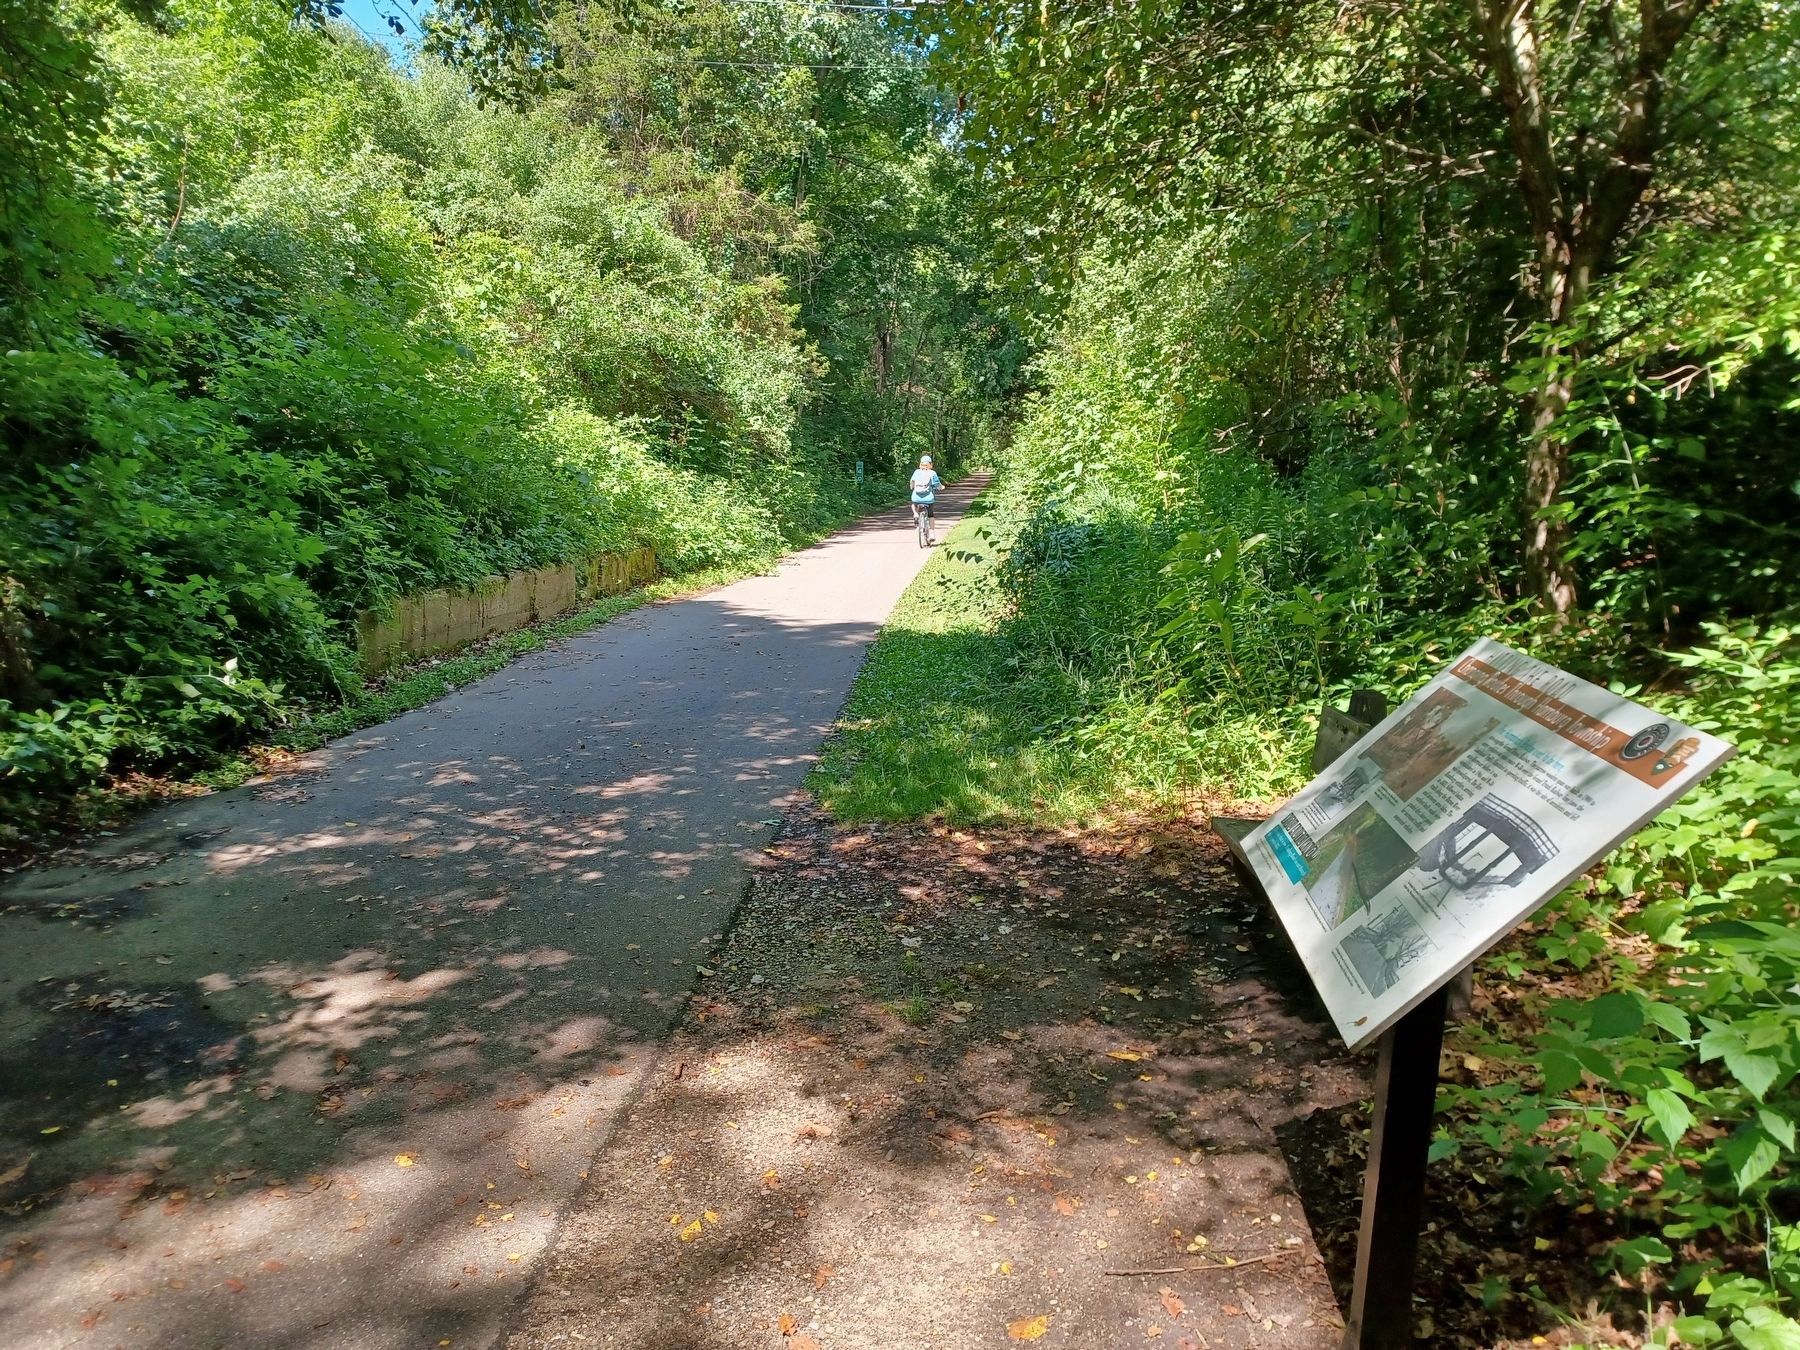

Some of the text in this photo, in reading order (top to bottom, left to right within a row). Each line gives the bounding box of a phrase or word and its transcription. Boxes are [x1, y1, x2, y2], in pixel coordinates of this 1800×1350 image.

[1519, 665, 1549, 685] THE
[1539, 674, 1578, 700] ROAD
[1502, 682, 1539, 711] Through
[1530, 697, 1574, 732] Hamburg
[1564, 714, 1613, 753] Township
